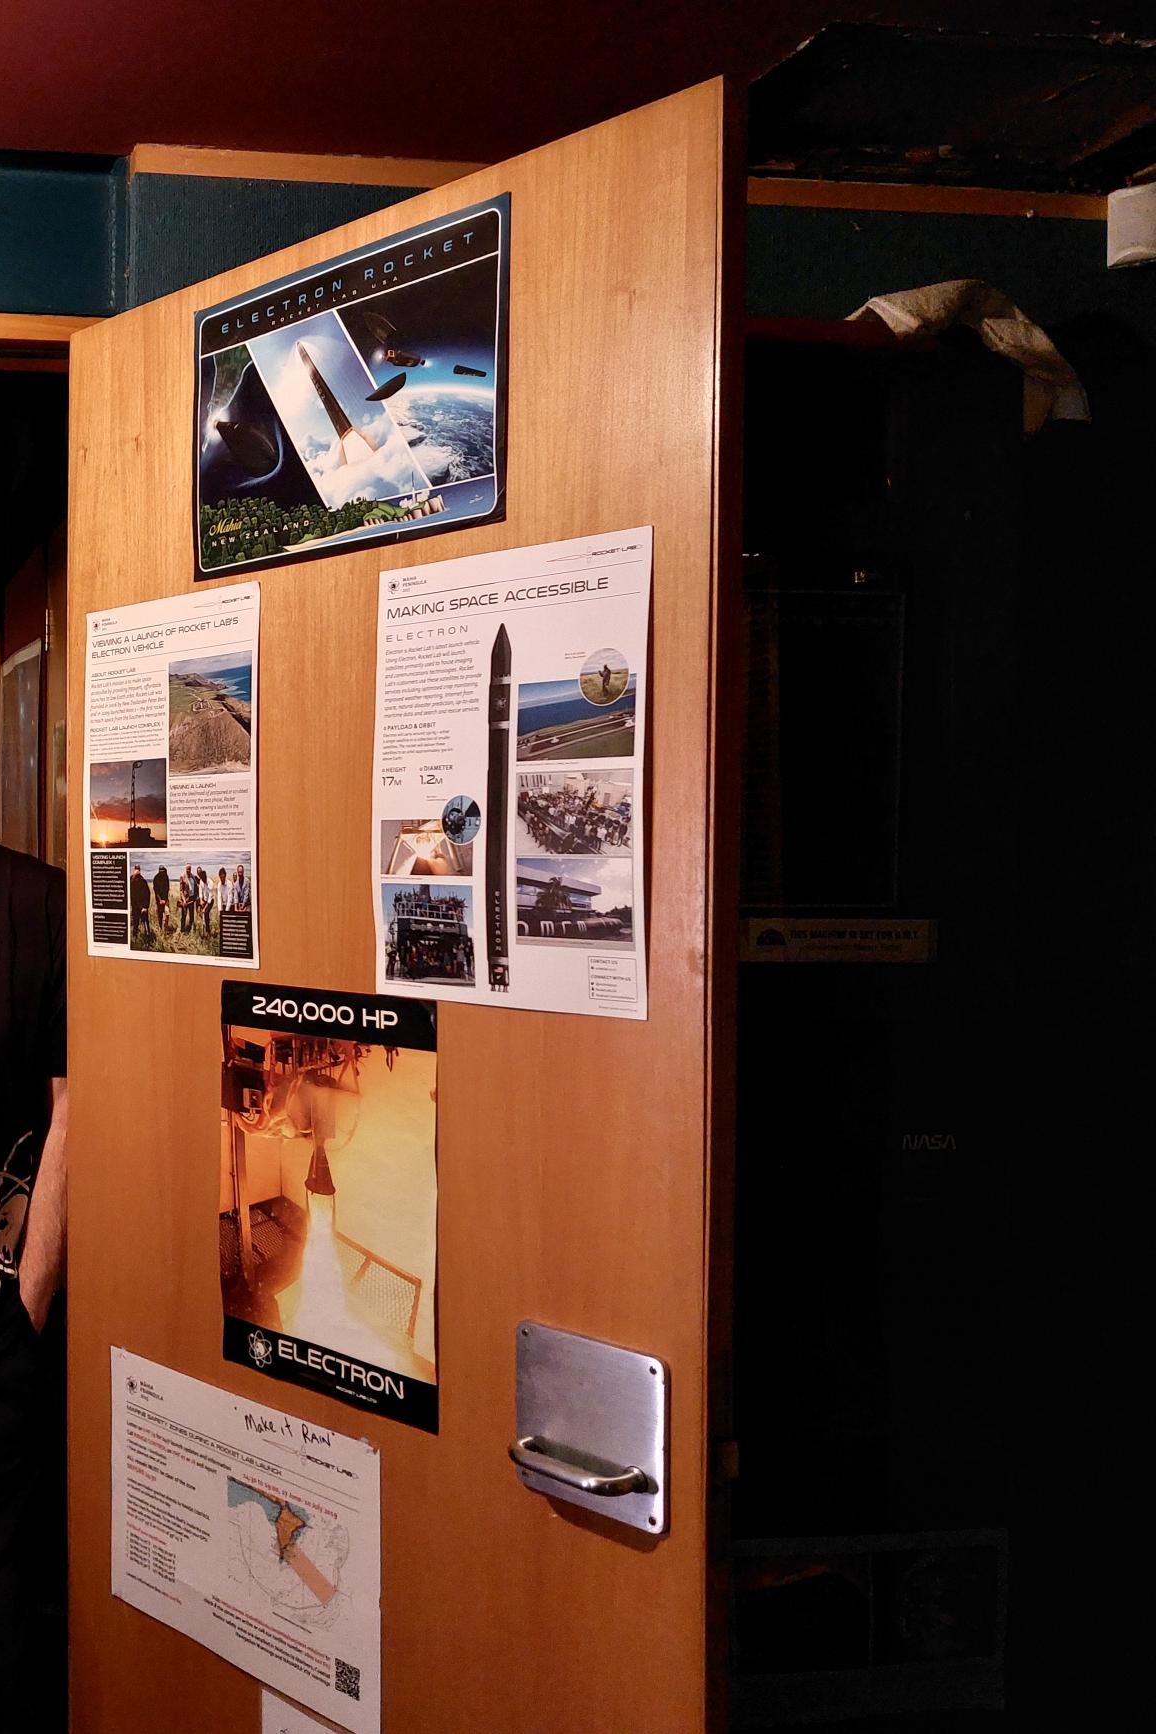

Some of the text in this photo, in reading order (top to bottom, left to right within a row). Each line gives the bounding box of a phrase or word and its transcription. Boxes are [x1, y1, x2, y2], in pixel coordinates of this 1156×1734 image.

[221, 231, 474, 334] ELECTRON ROCKET
[271, 275, 398, 326] ROCKET LAB USA
[211, 520, 310, 547] NEW ZEALAND
[387, 577, 609, 620] MAKING SPACE ACCESSIBLE
[92, 637, 123, 648] VIEWING
[131, 630, 163, 642] LAUNCH
[165, 627, 177, 636] OF
[178, 621, 211, 634] ROCKET
[213, 617, 239, 628] LAB'S
[386, 625, 469, 643] ELECTRON
[91, 641, 164, 659] ELECTRON VEHICLE
[138, 721, 161, 729] COMPLEX
[419, 721, 436, 729] ORBIT
[382, 774, 444, 787] 17M 1.2M
[251, 995, 398, 1030] 240,000 HP
[902, 1134, 957, 1150] NASA
[277, 1338, 405, 1400] ELECTRON
[126, 1404, 146, 1418] MARINE
[147, 1412, 167, 1426] SAFETY
[168, 1420, 188, 1437] ZONES
[188, 1430, 210, 1445] DURING
[216, 1444, 239, 1459] ROCKET
[240, 1454, 254, 1466] LAB
[255, 1461, 282, 1476] LAUNCH
[280, 1417, 293, 1437] it
